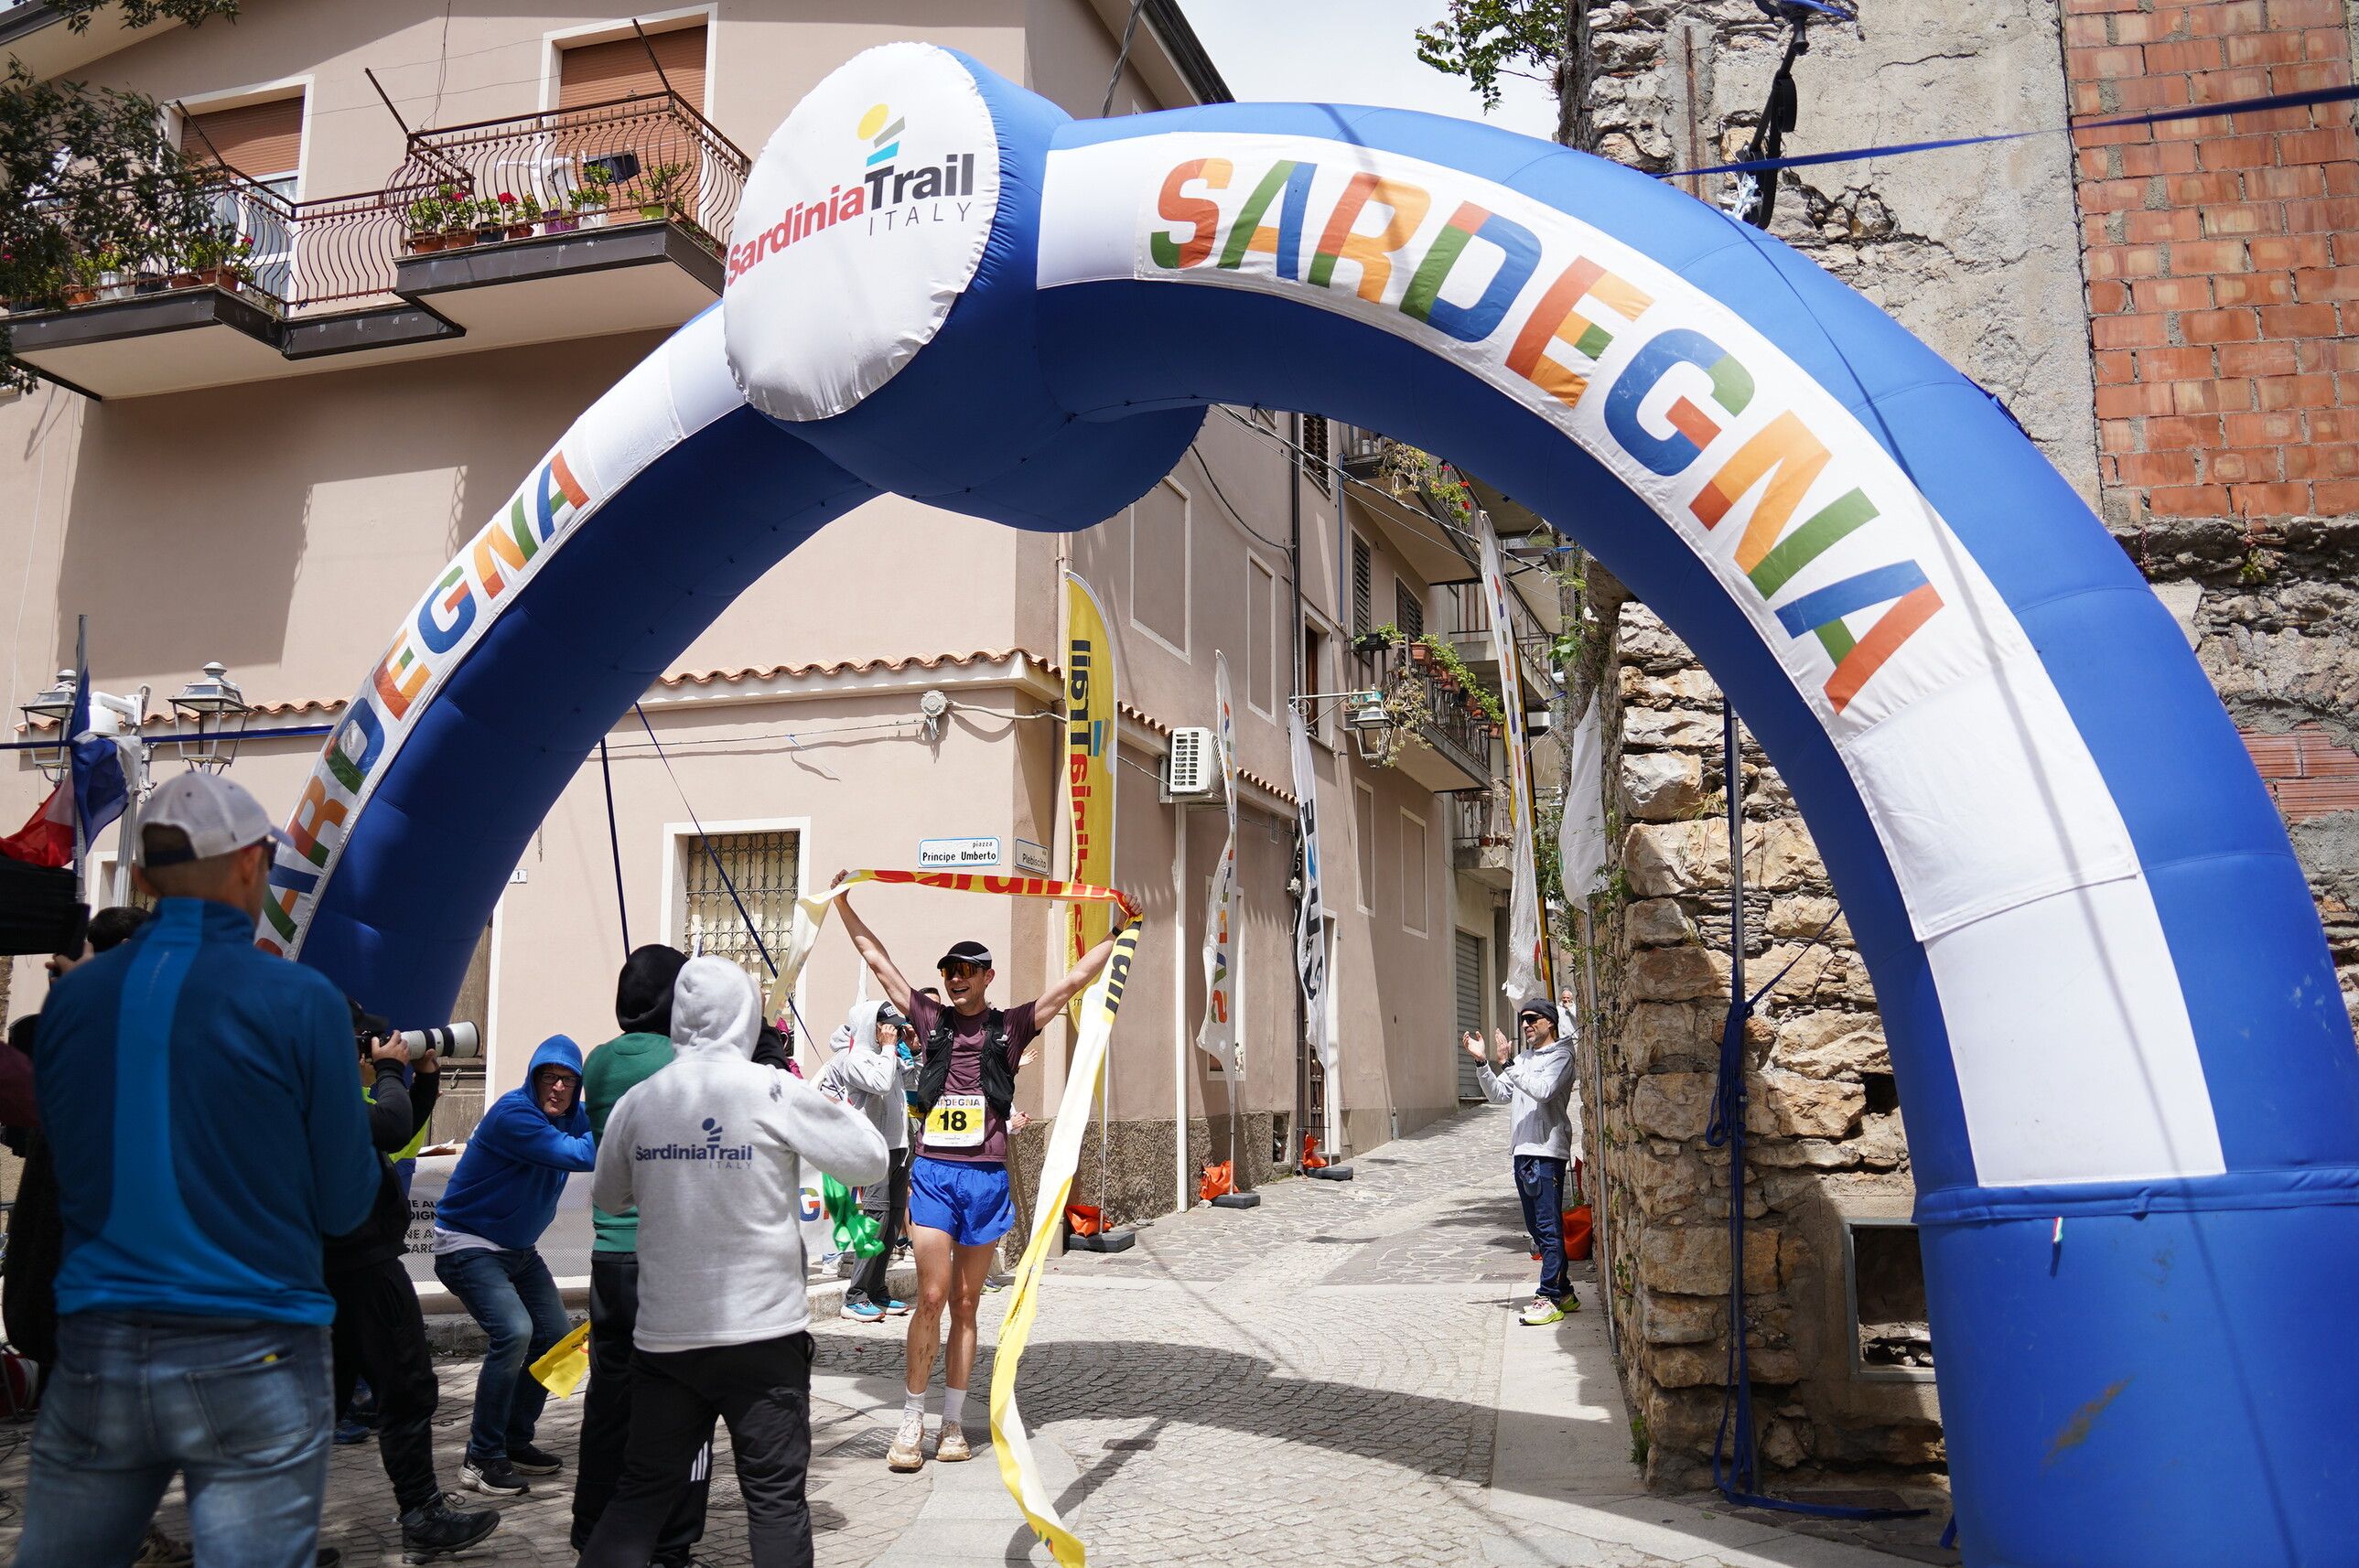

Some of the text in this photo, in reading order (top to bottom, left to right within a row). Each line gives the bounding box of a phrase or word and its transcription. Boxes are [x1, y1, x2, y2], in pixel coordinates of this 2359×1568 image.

[727, 153, 975, 287] SardiniaTrail
[868, 202, 972, 236] ITALY
[1150, 157, 1944, 714] SARDEGNA
[255, 450, 590, 957] ARDEGNA
[922, 851, 996, 863] Principe Umberto
[1022, 853, 1047, 868] Plebiscito
[940, 1111, 967, 1131] 18
[635, 1144, 752, 1161] SardiniaTrail
[708, 1161, 751, 1170] ITALY
